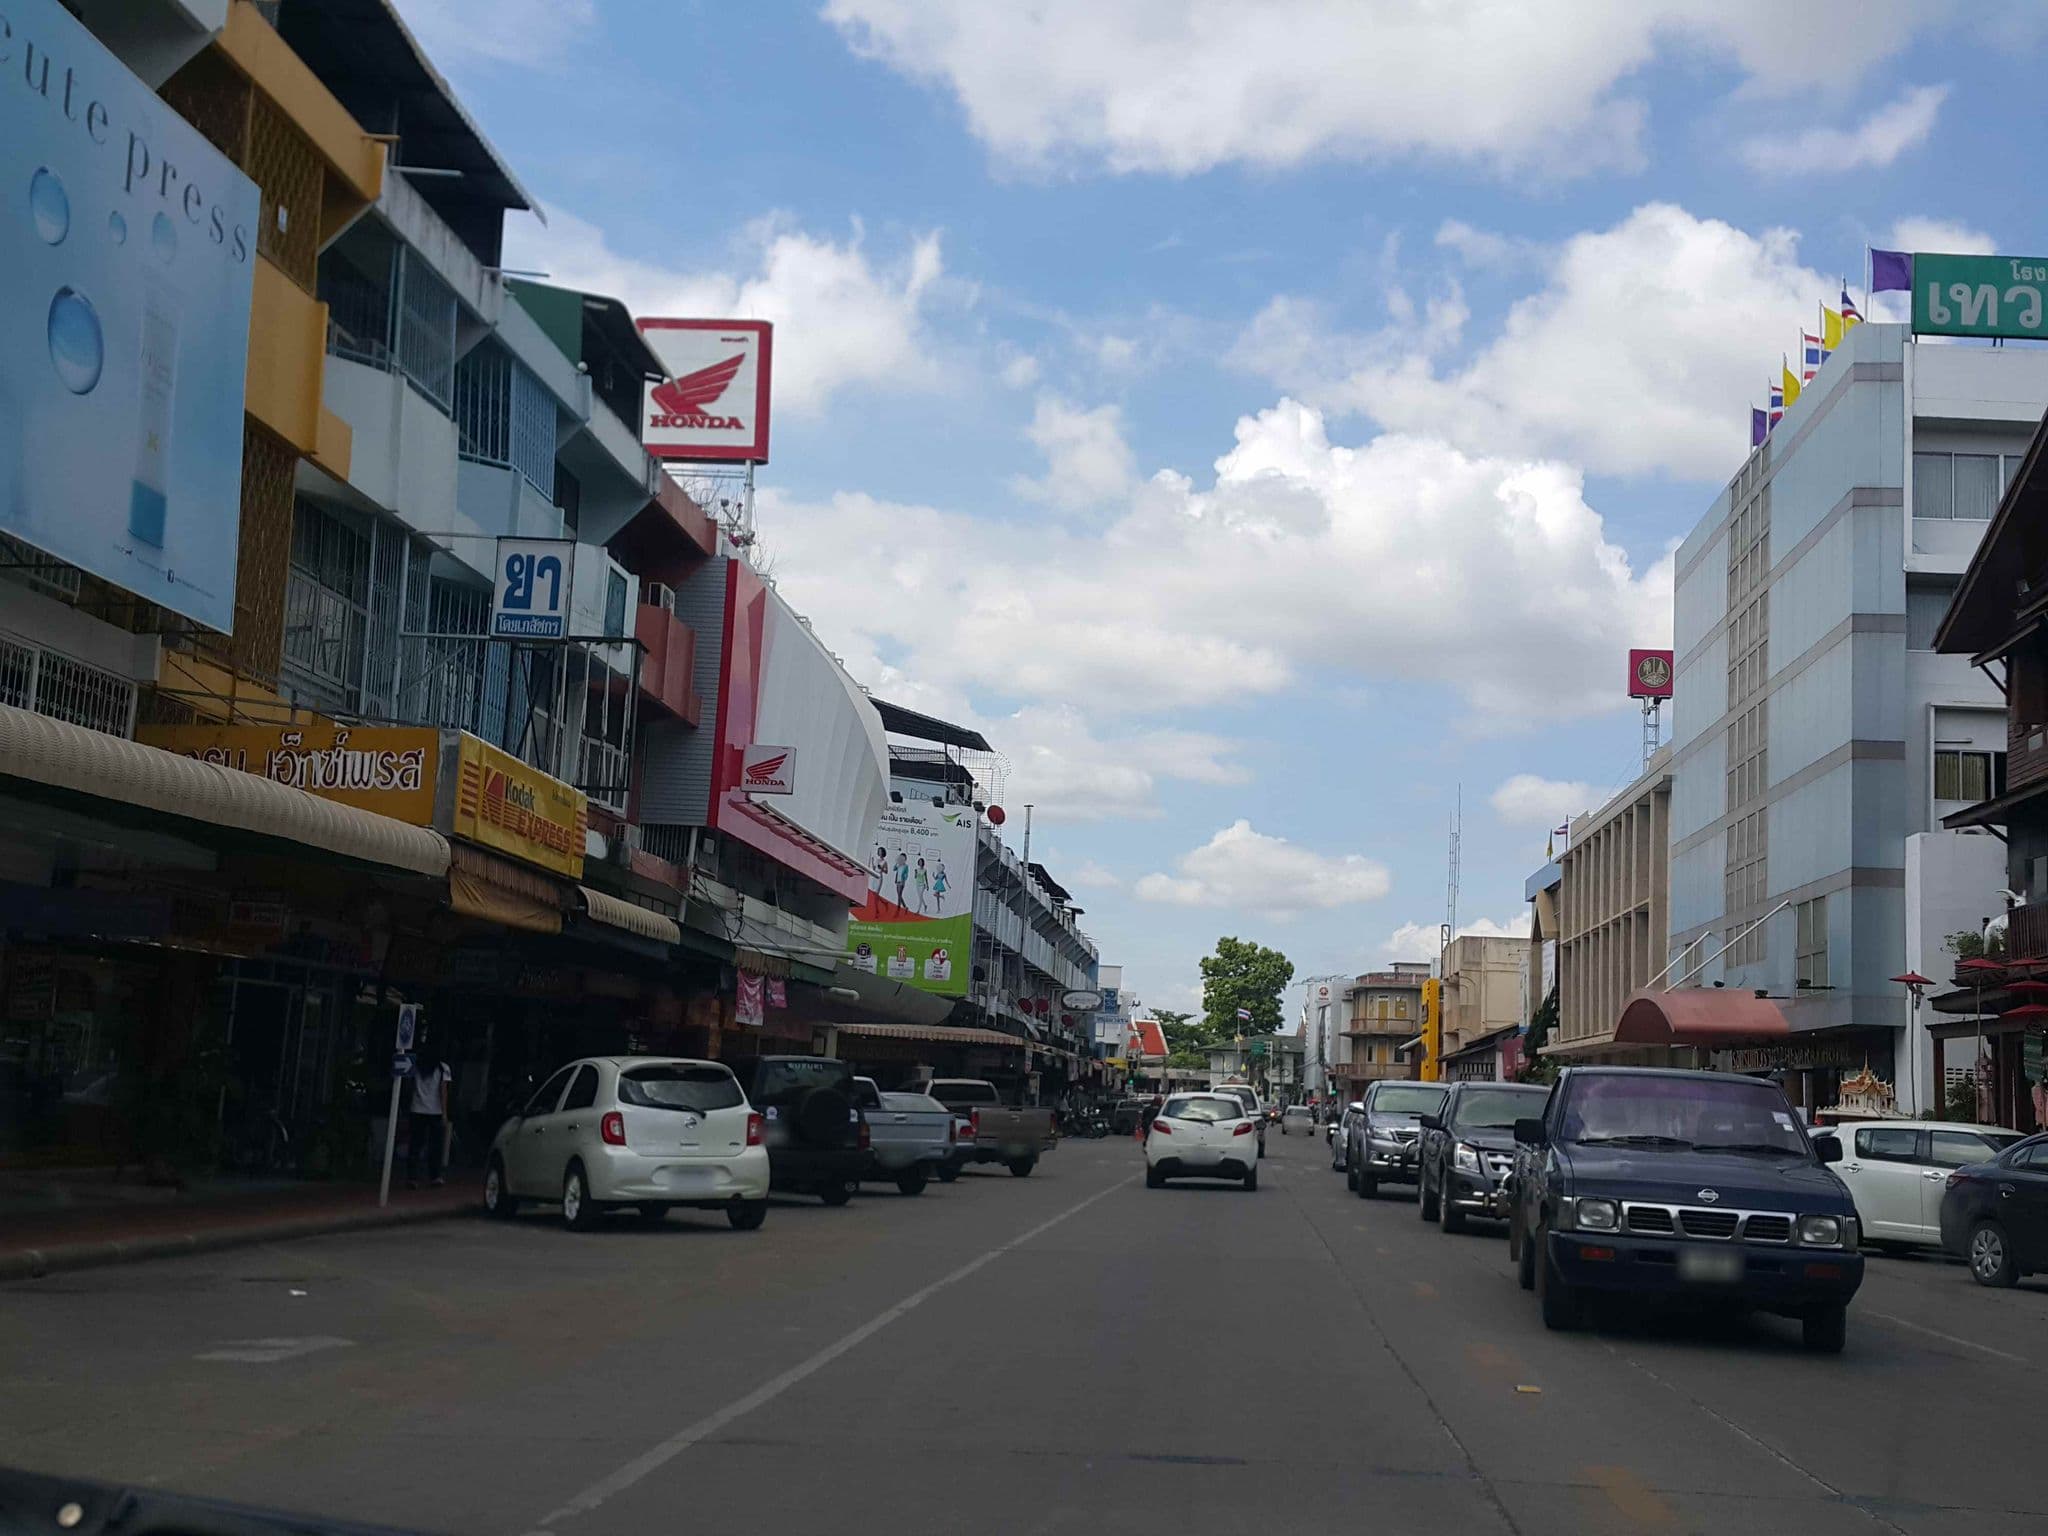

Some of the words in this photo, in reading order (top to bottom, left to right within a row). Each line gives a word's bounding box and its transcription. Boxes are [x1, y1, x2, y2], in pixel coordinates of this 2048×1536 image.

[123, 130, 248, 264] press
[1929, 281, 2042, 328] เทว
[650, 414, 745, 430] HONDA
[503, 553, 562, 611] ยา
[505, 775, 535, 812] Kodak
[745, 778, 786, 786] HONDA
[518, 810, 572, 856] EXPRESS
[955, 819, 972, 829] AIS
